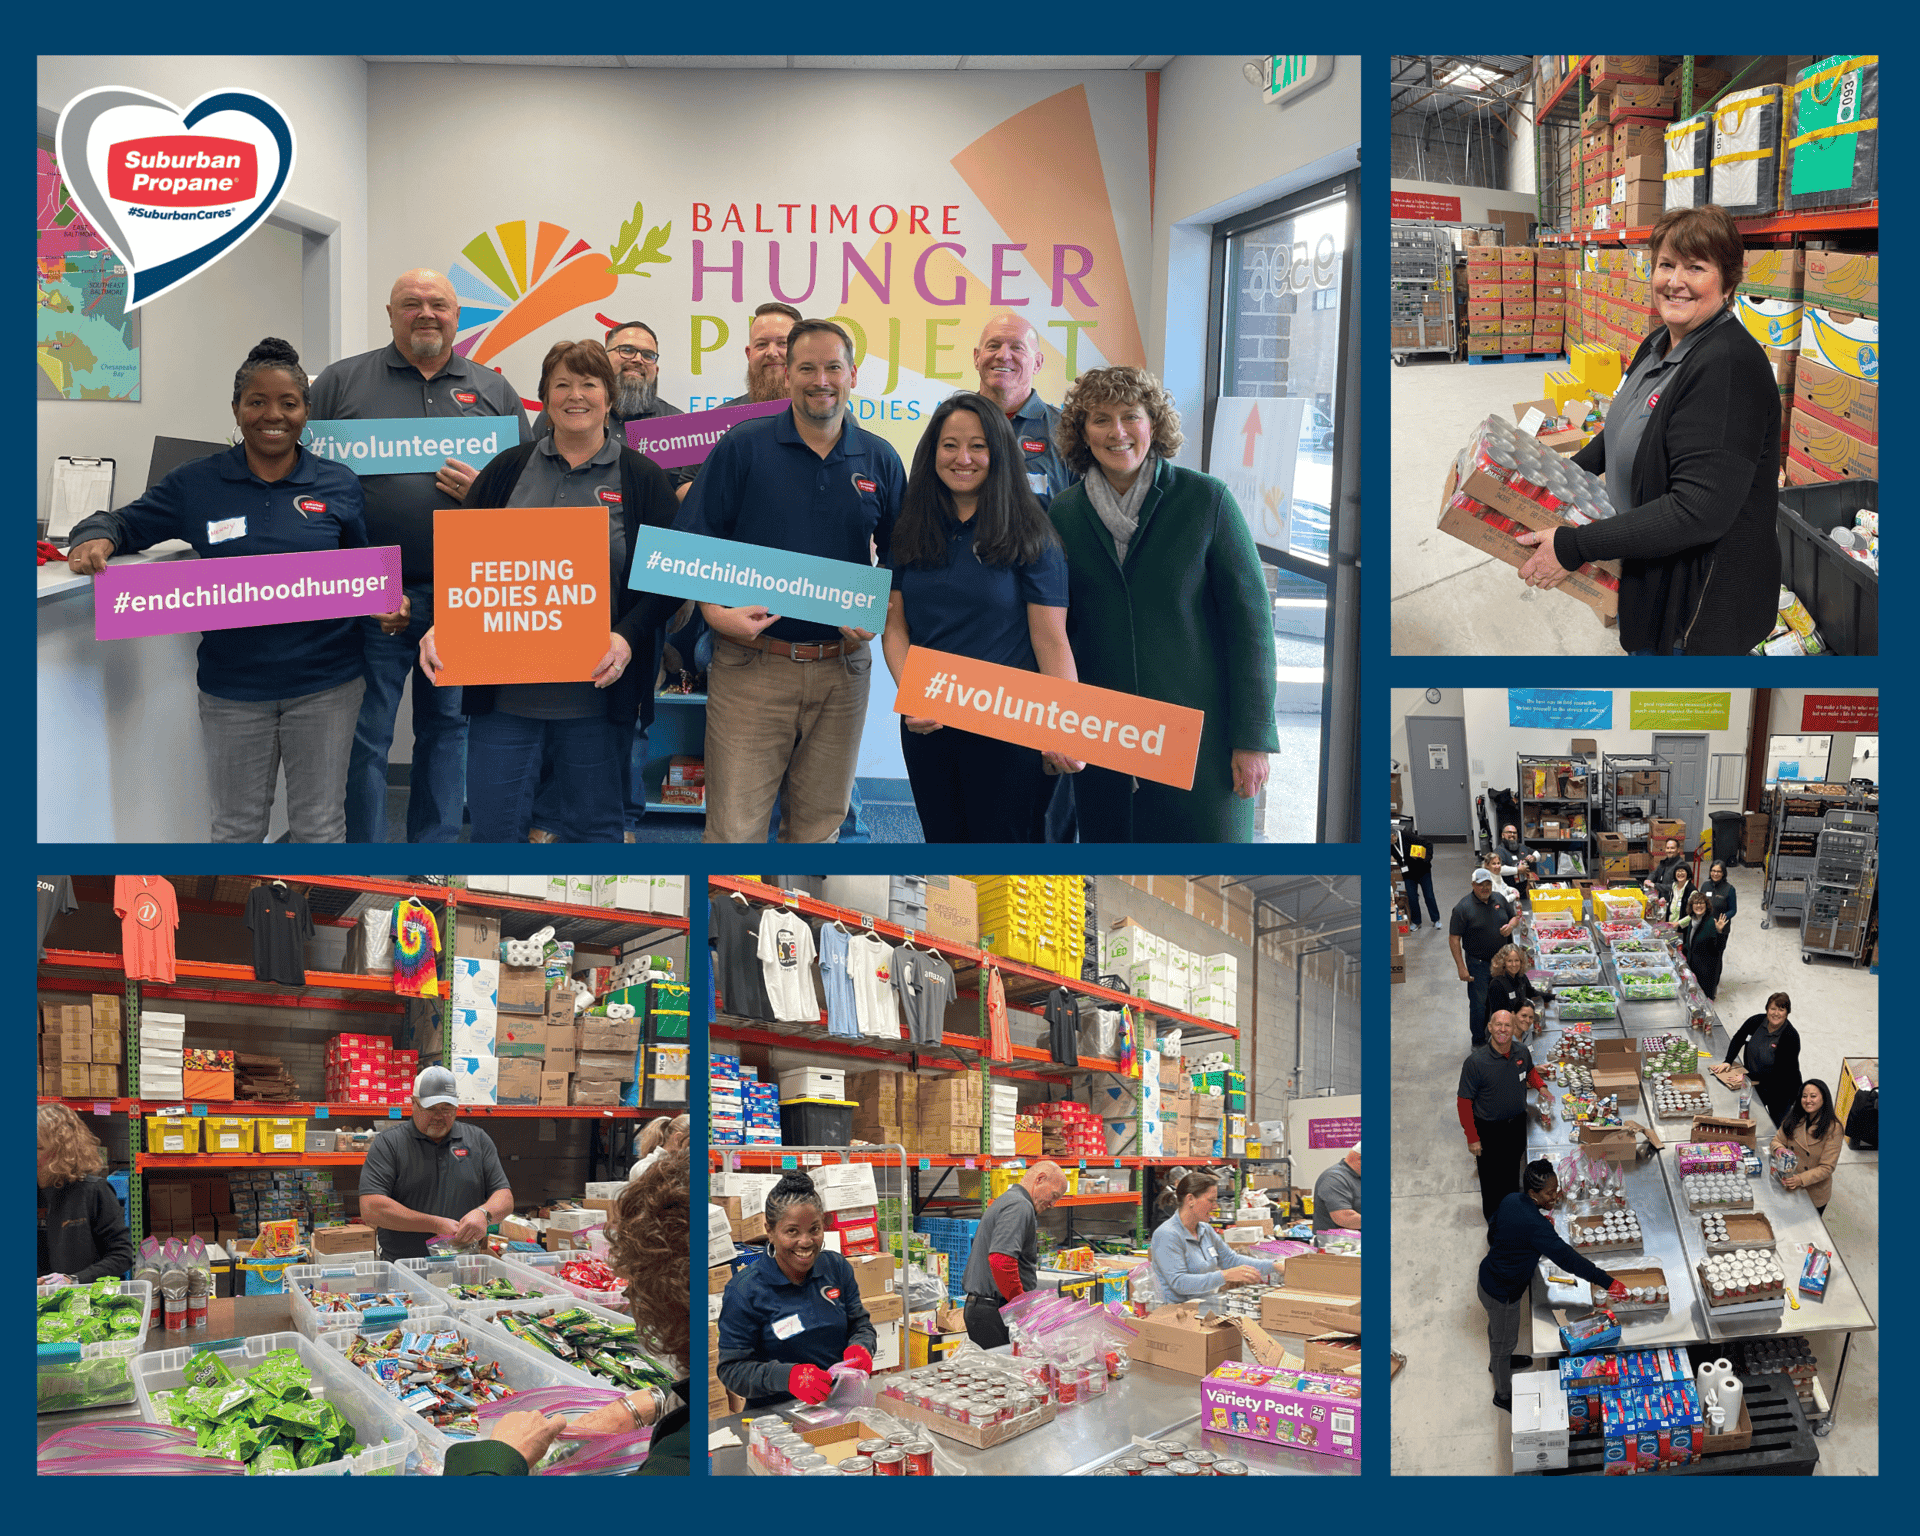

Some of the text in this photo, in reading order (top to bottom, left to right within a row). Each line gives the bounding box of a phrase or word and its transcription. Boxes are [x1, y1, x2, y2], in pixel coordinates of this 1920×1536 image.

[691, 202, 962, 235] BALTIMORE
[691, 239, 1101, 308] HUNGER
[310, 431, 498, 460] #ivolunteered
[470, 558, 574, 583] FEEDING
[645, 550, 877, 612] #endchildhoodhunger
[113, 572, 389, 615] #endchildhoodhunger
[447, 582, 597, 609] BODIES AND
[482, 609, 563, 633] MINDS
[924, 671, 1167, 756] #ivolunteered
[933, 902, 958, 914] green
[402, 919, 428, 934] amazon
[1111, 946, 1127, 958] LED
[924, 970, 946, 986] amazon
[1206, 1388, 1304, 1418] Variety Pack
[1312, 1406, 1324, 1416] 25
